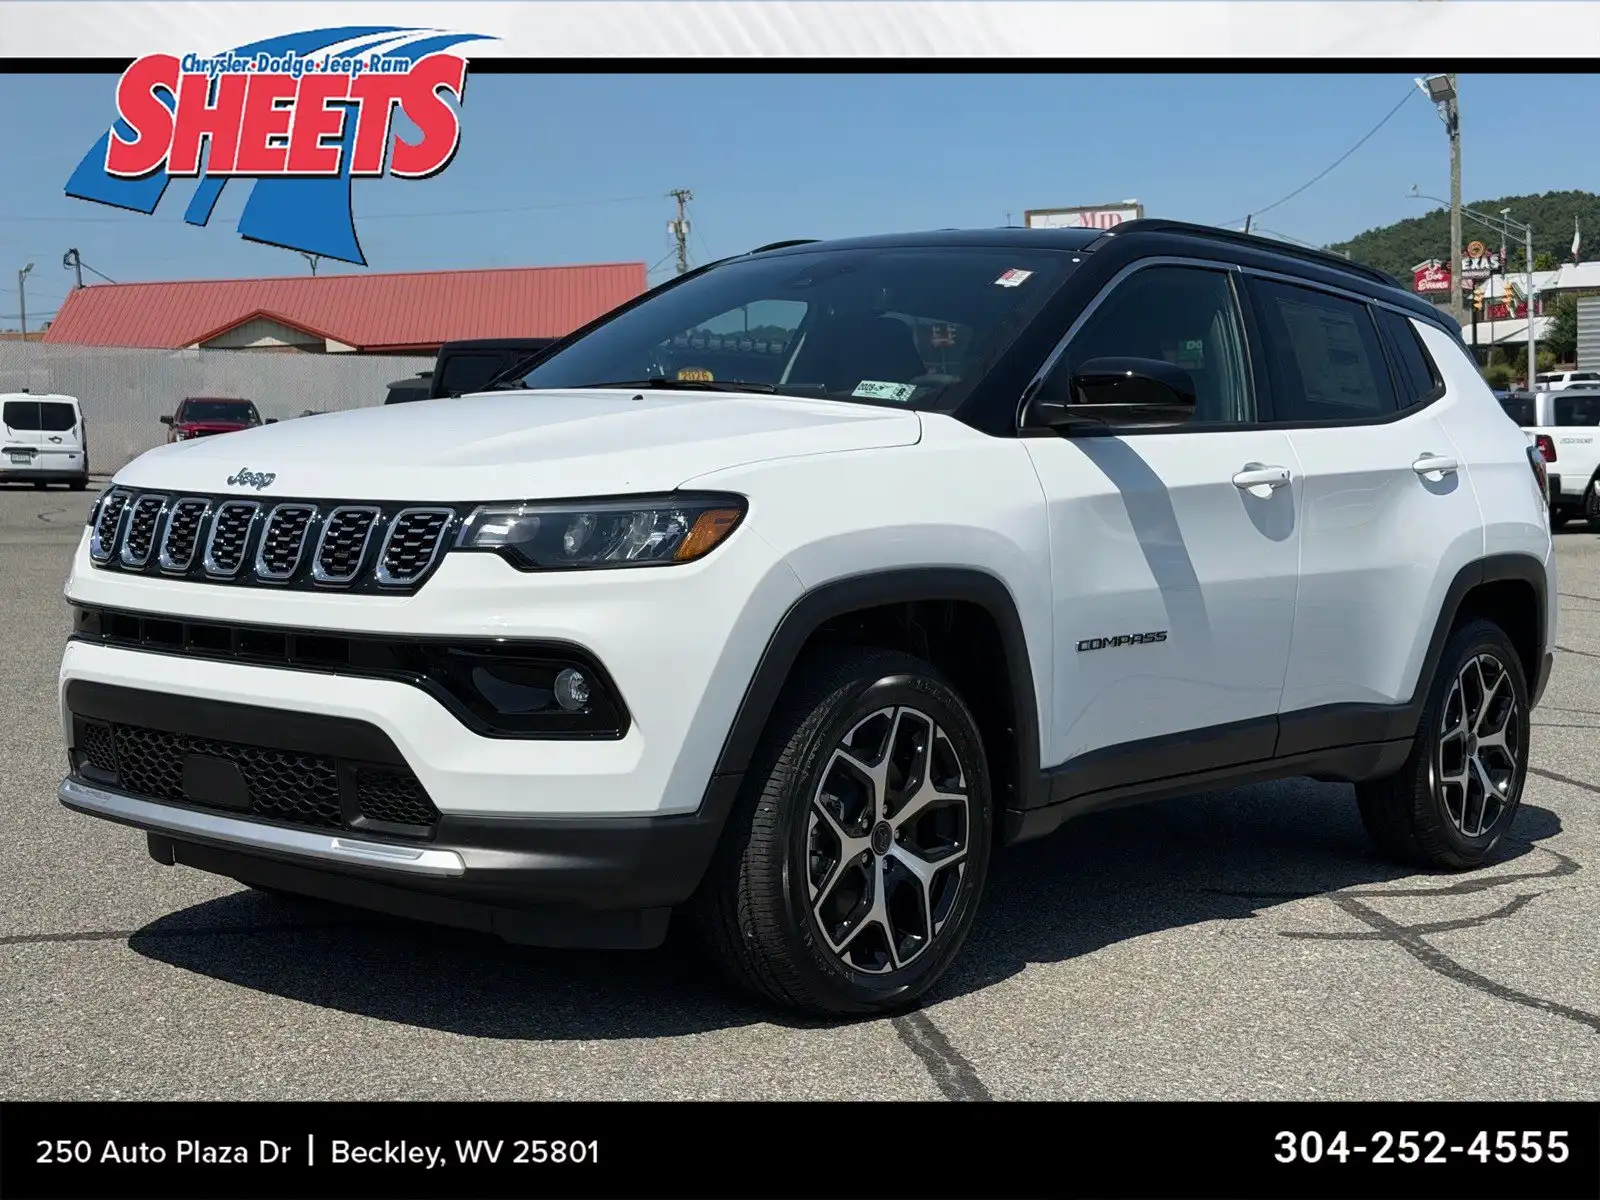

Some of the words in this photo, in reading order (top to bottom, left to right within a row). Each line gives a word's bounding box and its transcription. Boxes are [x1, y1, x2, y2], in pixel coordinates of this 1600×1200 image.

[1461, 255, 1500, 271] EXAS
[226, 467, 277, 492] Jeep
[1076, 630, 1168, 652] COMPASS
